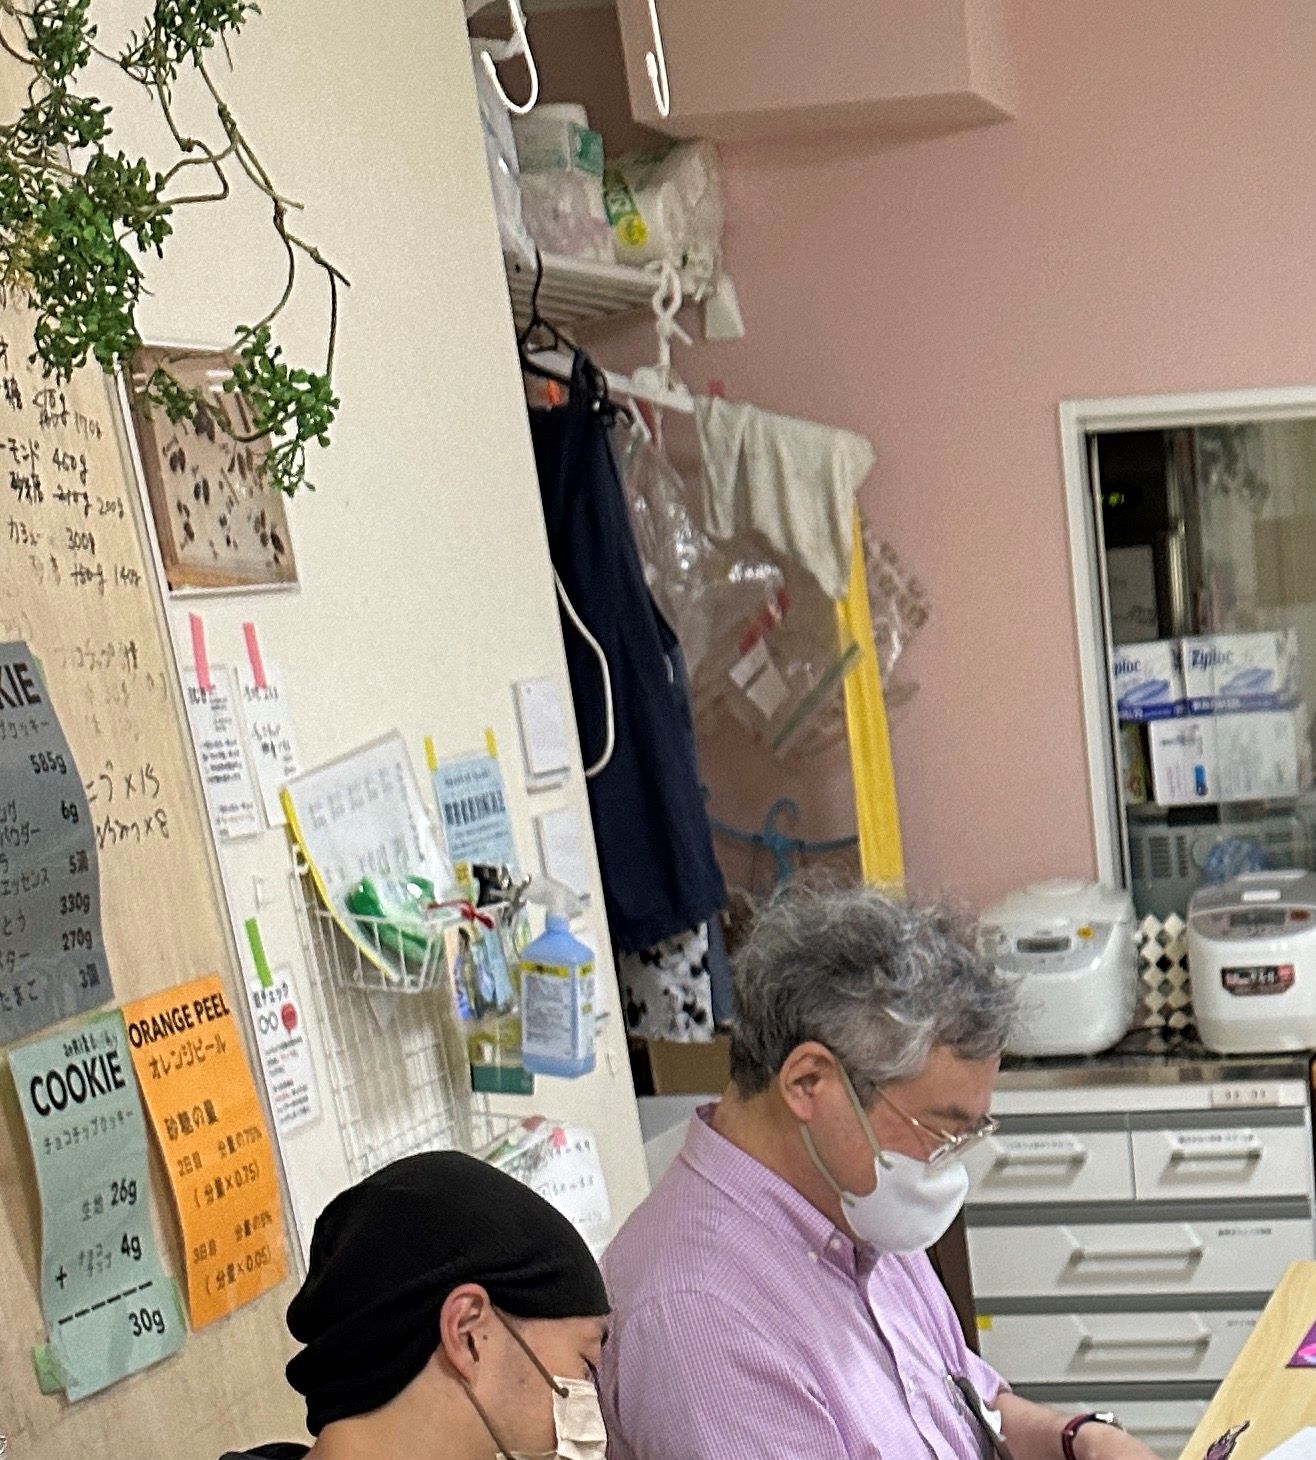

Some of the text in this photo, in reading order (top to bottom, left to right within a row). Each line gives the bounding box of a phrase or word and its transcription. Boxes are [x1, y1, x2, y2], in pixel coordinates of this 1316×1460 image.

[61, 799, 79, 824] 6g
[60, 892, 91, 915] 330g
[128, 1003, 195, 1048] ORANGE
[193, 992, 231, 1025] PEEL
[30, 1050, 126, 1117] COOKIE
[111, 1177, 137, 1207] 26g
[120, 1232, 143, 1262] 4g
[128, 1307, 166, 1337] 30g
